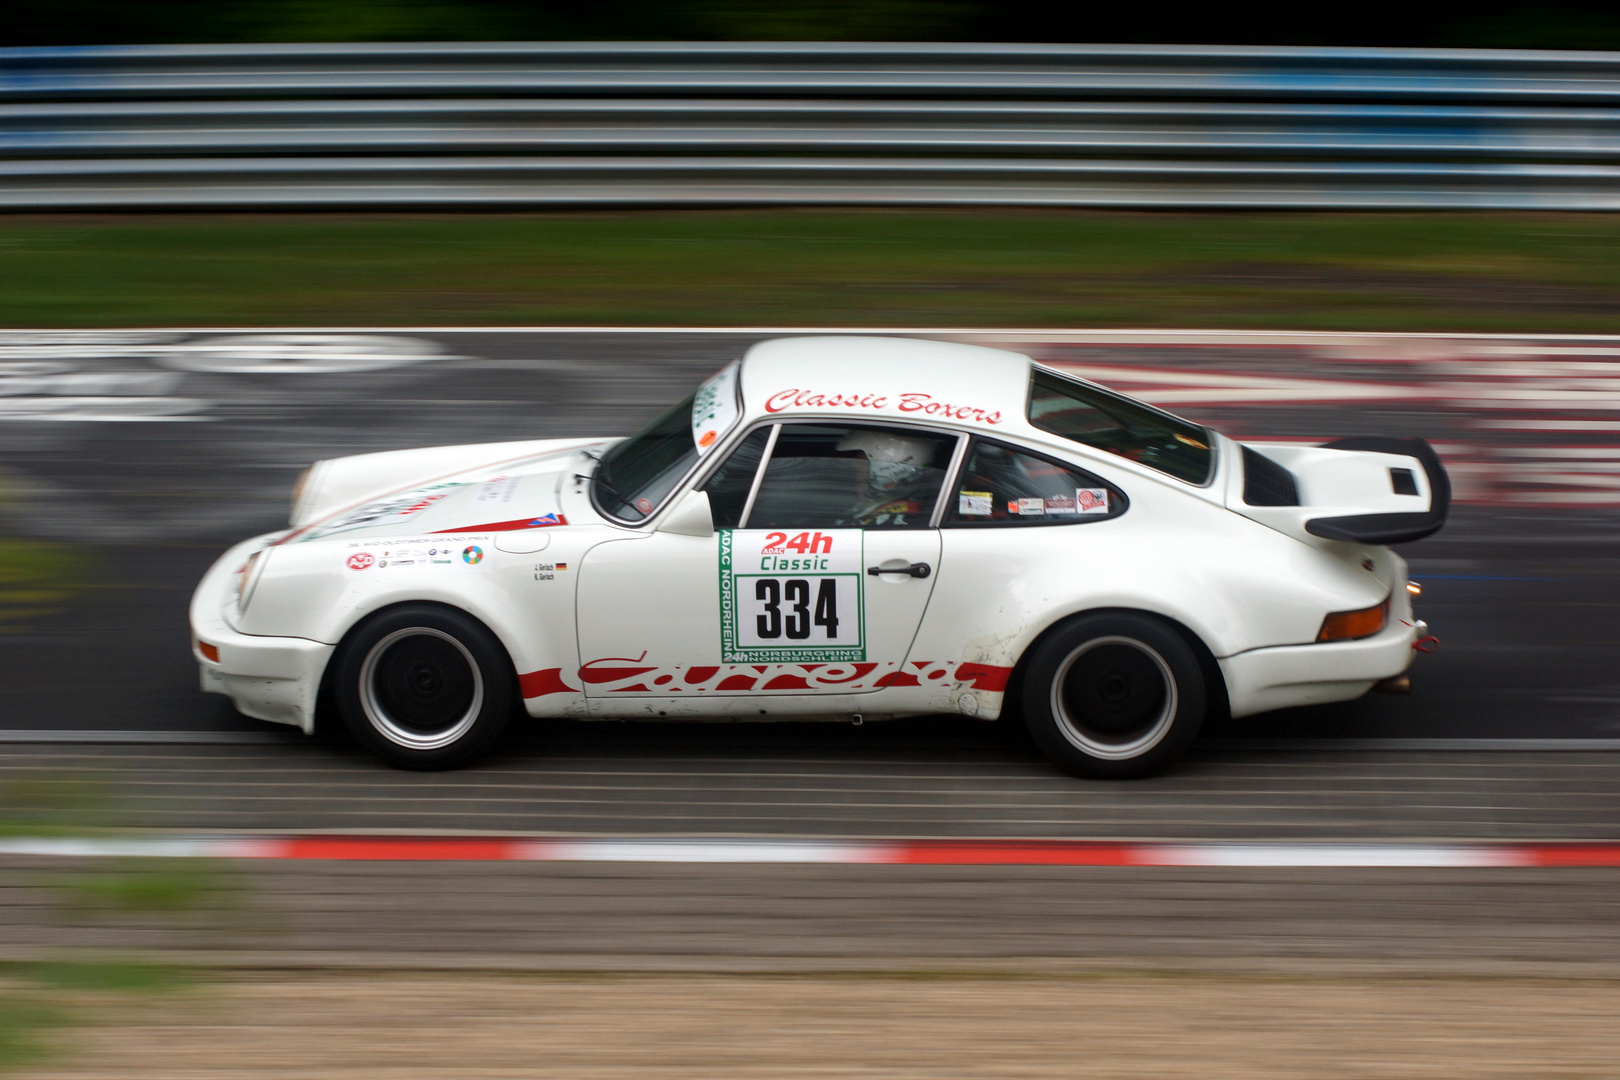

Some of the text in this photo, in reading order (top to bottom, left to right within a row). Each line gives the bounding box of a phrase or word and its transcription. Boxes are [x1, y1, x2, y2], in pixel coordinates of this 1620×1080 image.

[764, 388, 1003, 424] Classic Boxers
[761, 532, 833, 554] 24h
[760, 555, 829, 571] Classic
[721, 530, 732, 651] ADAC NORDRHEIN
[755, 578, 839, 640] 334
[560, 650, 977, 693] Carrera
[723, 652, 749, 662] 24h
